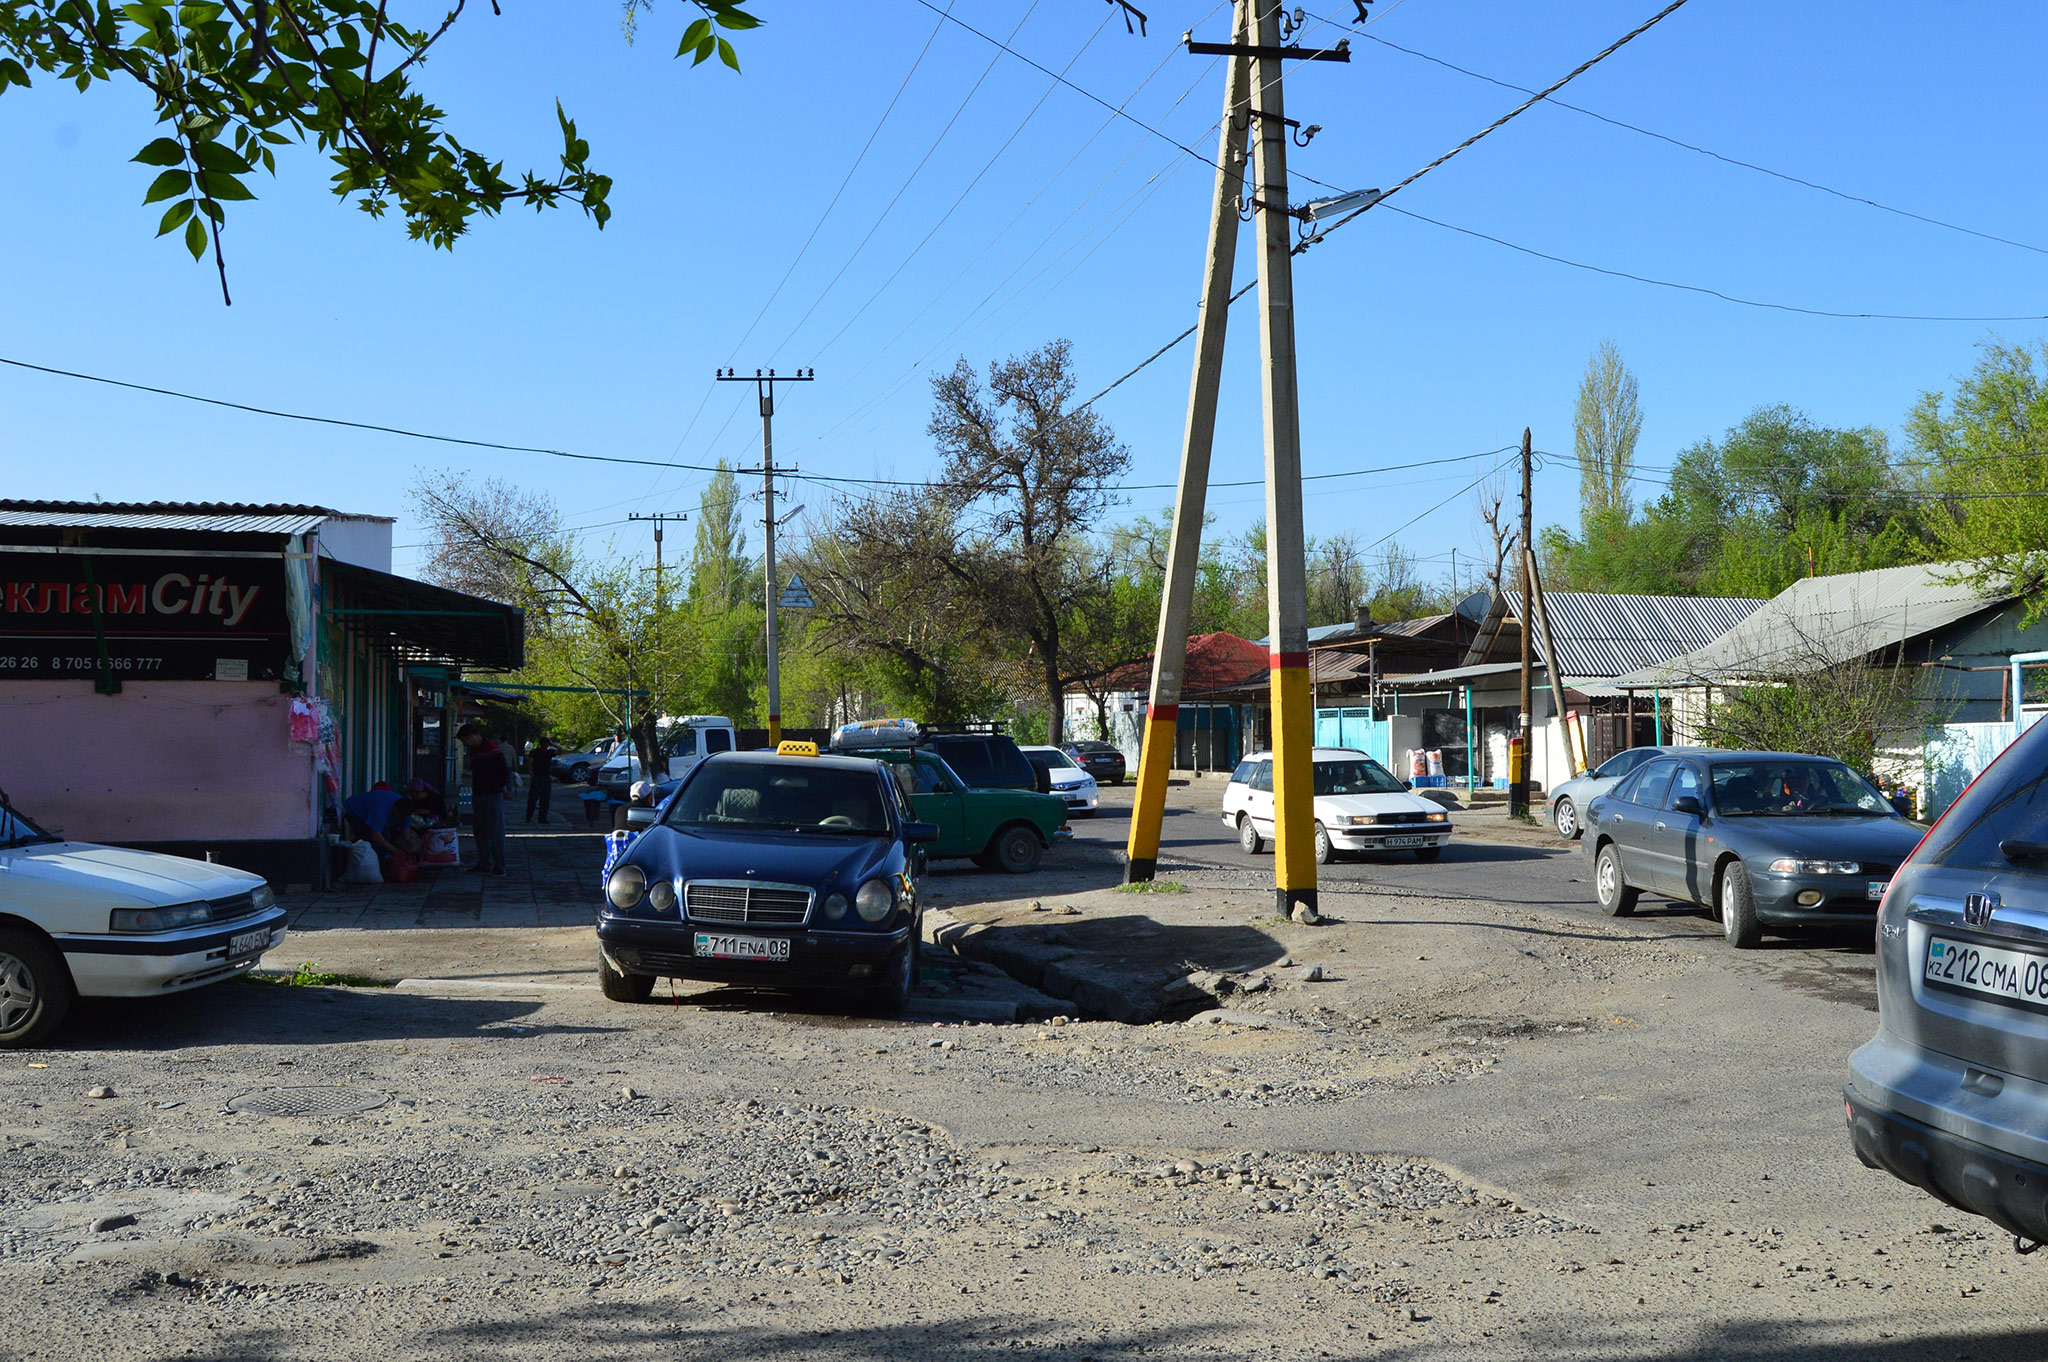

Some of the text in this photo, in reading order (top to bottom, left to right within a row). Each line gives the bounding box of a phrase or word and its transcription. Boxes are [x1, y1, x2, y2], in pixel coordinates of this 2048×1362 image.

[21, 656, 38, 669] 26
[52, 657, 61, 669] 8
[66, 657, 92, 669] 705
[136, 658, 162, 670] 777
[696, 944, 708, 952] KZ
[769, 940, 788, 956] 08
[1928, 961, 1943, 977] KZ
